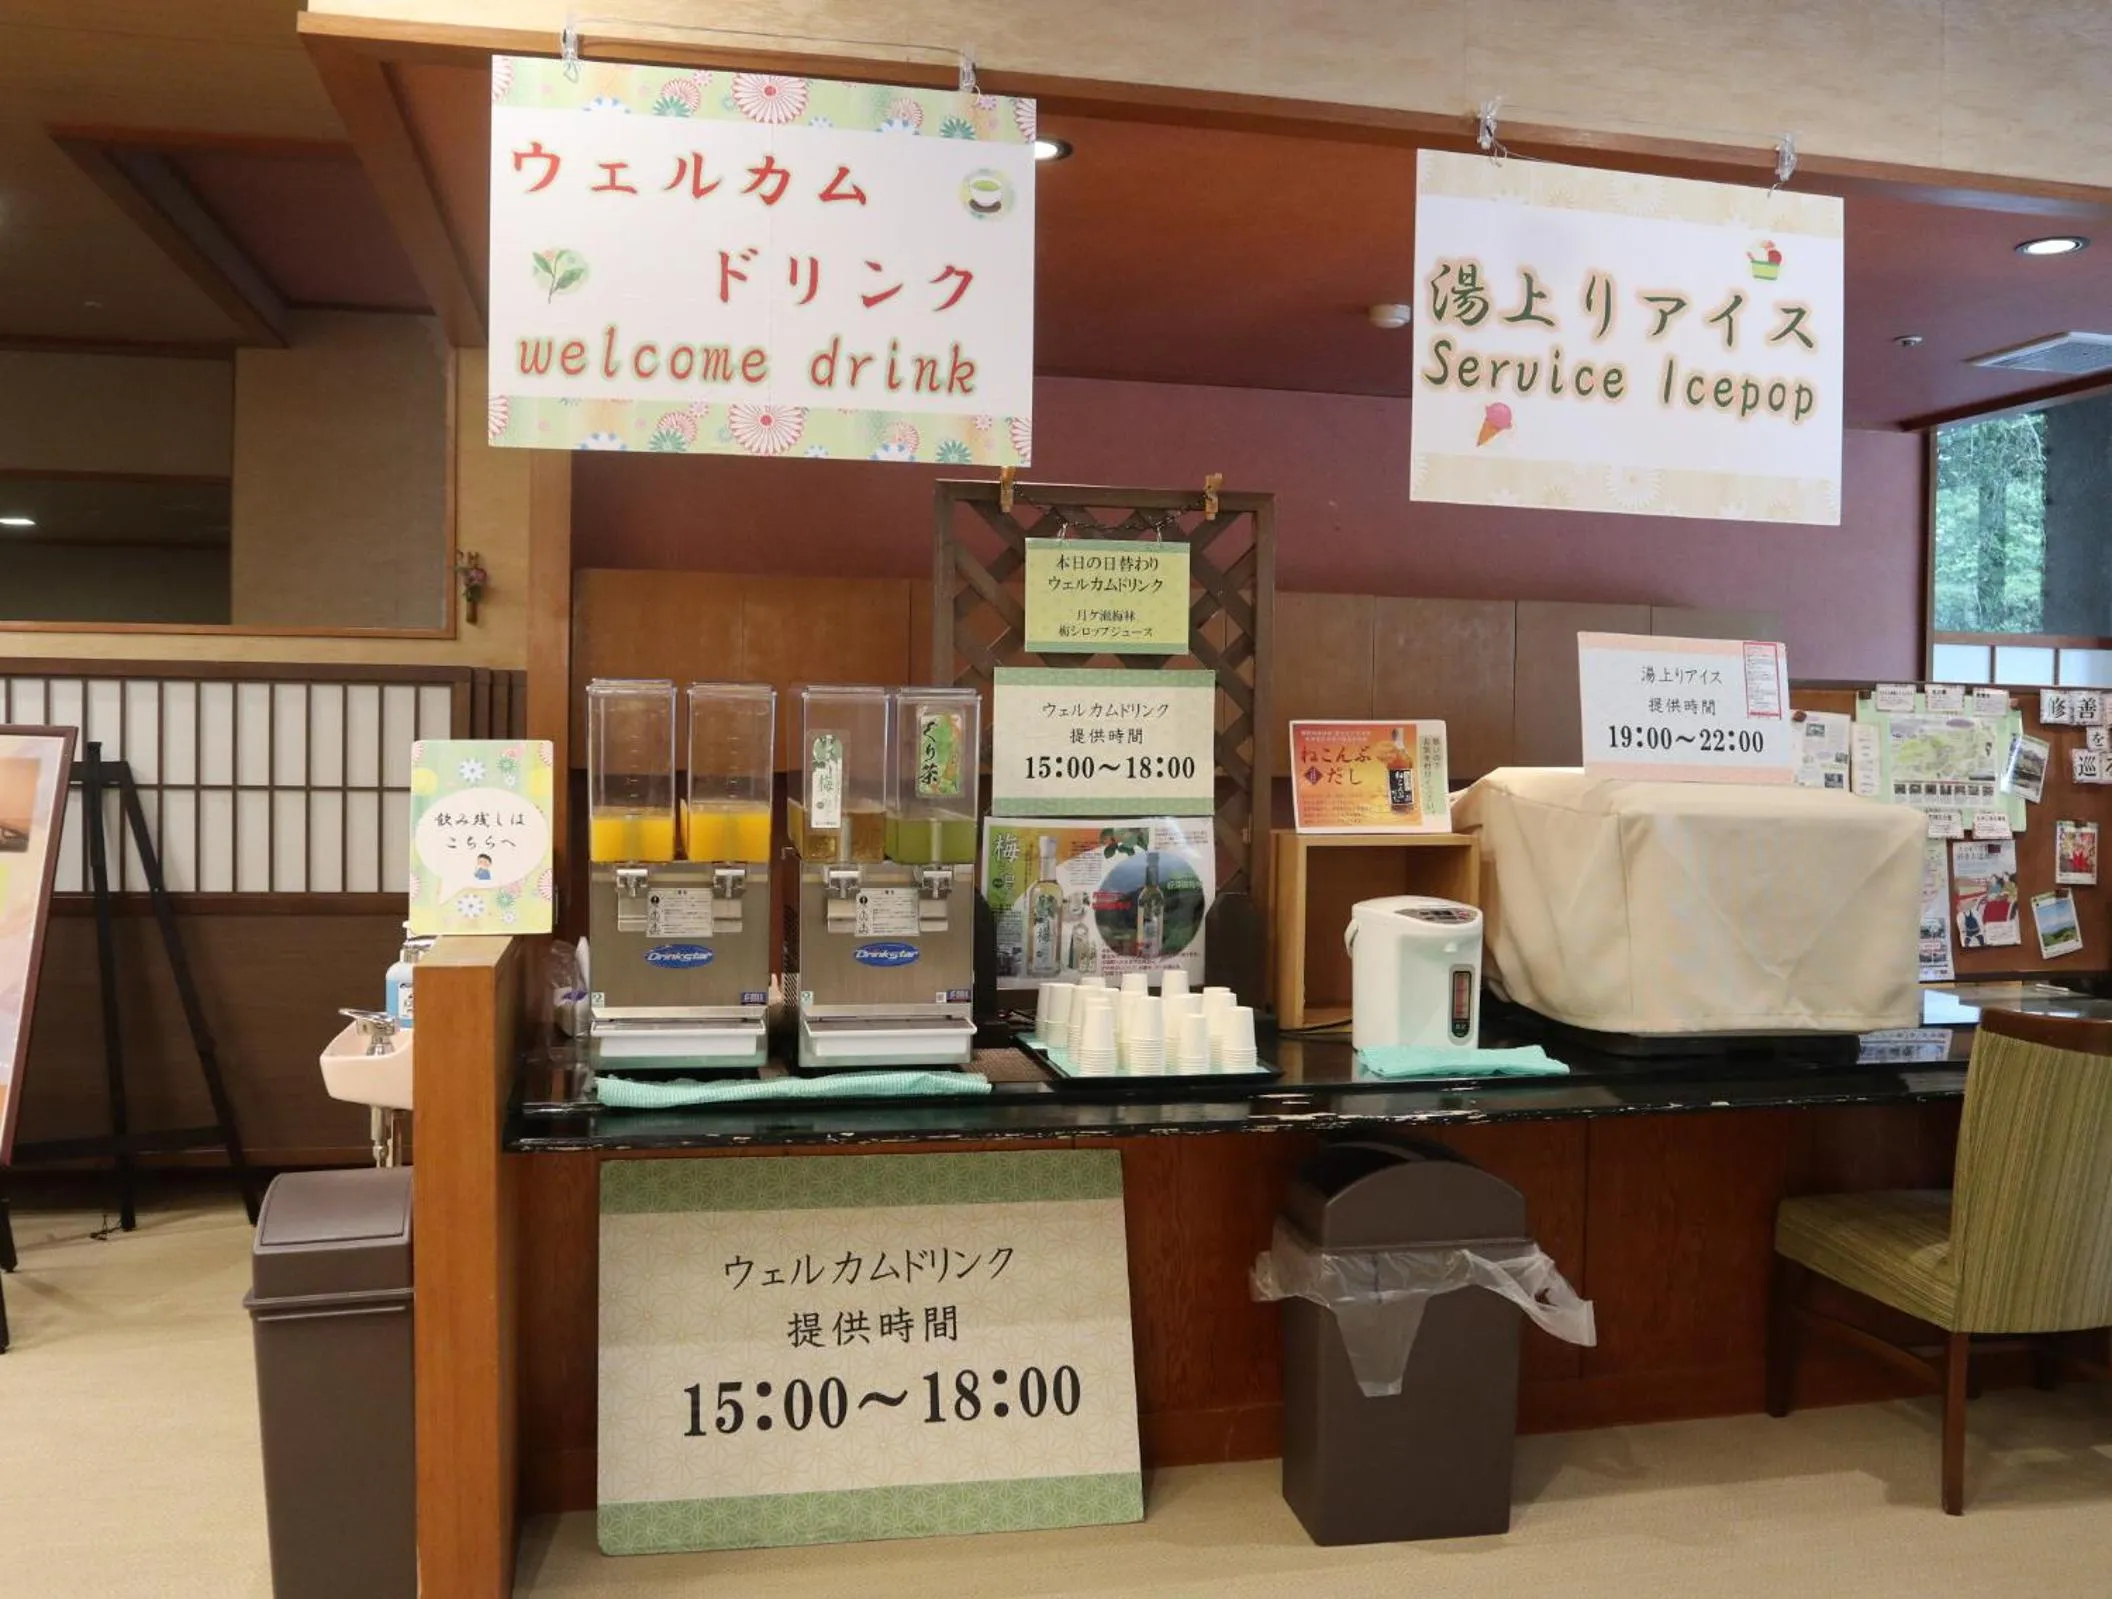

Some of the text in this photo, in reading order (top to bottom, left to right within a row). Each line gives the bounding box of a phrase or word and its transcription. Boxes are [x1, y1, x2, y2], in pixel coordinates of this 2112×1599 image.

[512, 140, 868, 207] ウェルカム
[718, 248, 976, 312] ドリンク
[1431, 263, 1815, 349] 湯上りアイス
[517, 325, 979, 396] welcome drink
[1424, 338, 1816, 422] Service Icepop
[1056, 554, 1160, 573] 本日の日替わり
[1048, 576, 1164, 594] ウェルカムドリンク
[1641, 665, 1723, 685] 湯上りアイス
[1042, 702, 1170, 719] ウェルカムドリンク
[1648, 697, 1717, 716] 提供時間
[1070, 728, 1144, 744] 提供時間
[1326, 767, 1363, 785] だし
[434, 812, 525, 827] 飲み残しは
[447, 835, 517, 849] こちらへ
[724, 1247, 1014, 1290] ウェルカムドリンク
[787, 1306, 958, 1348] 提供時間
